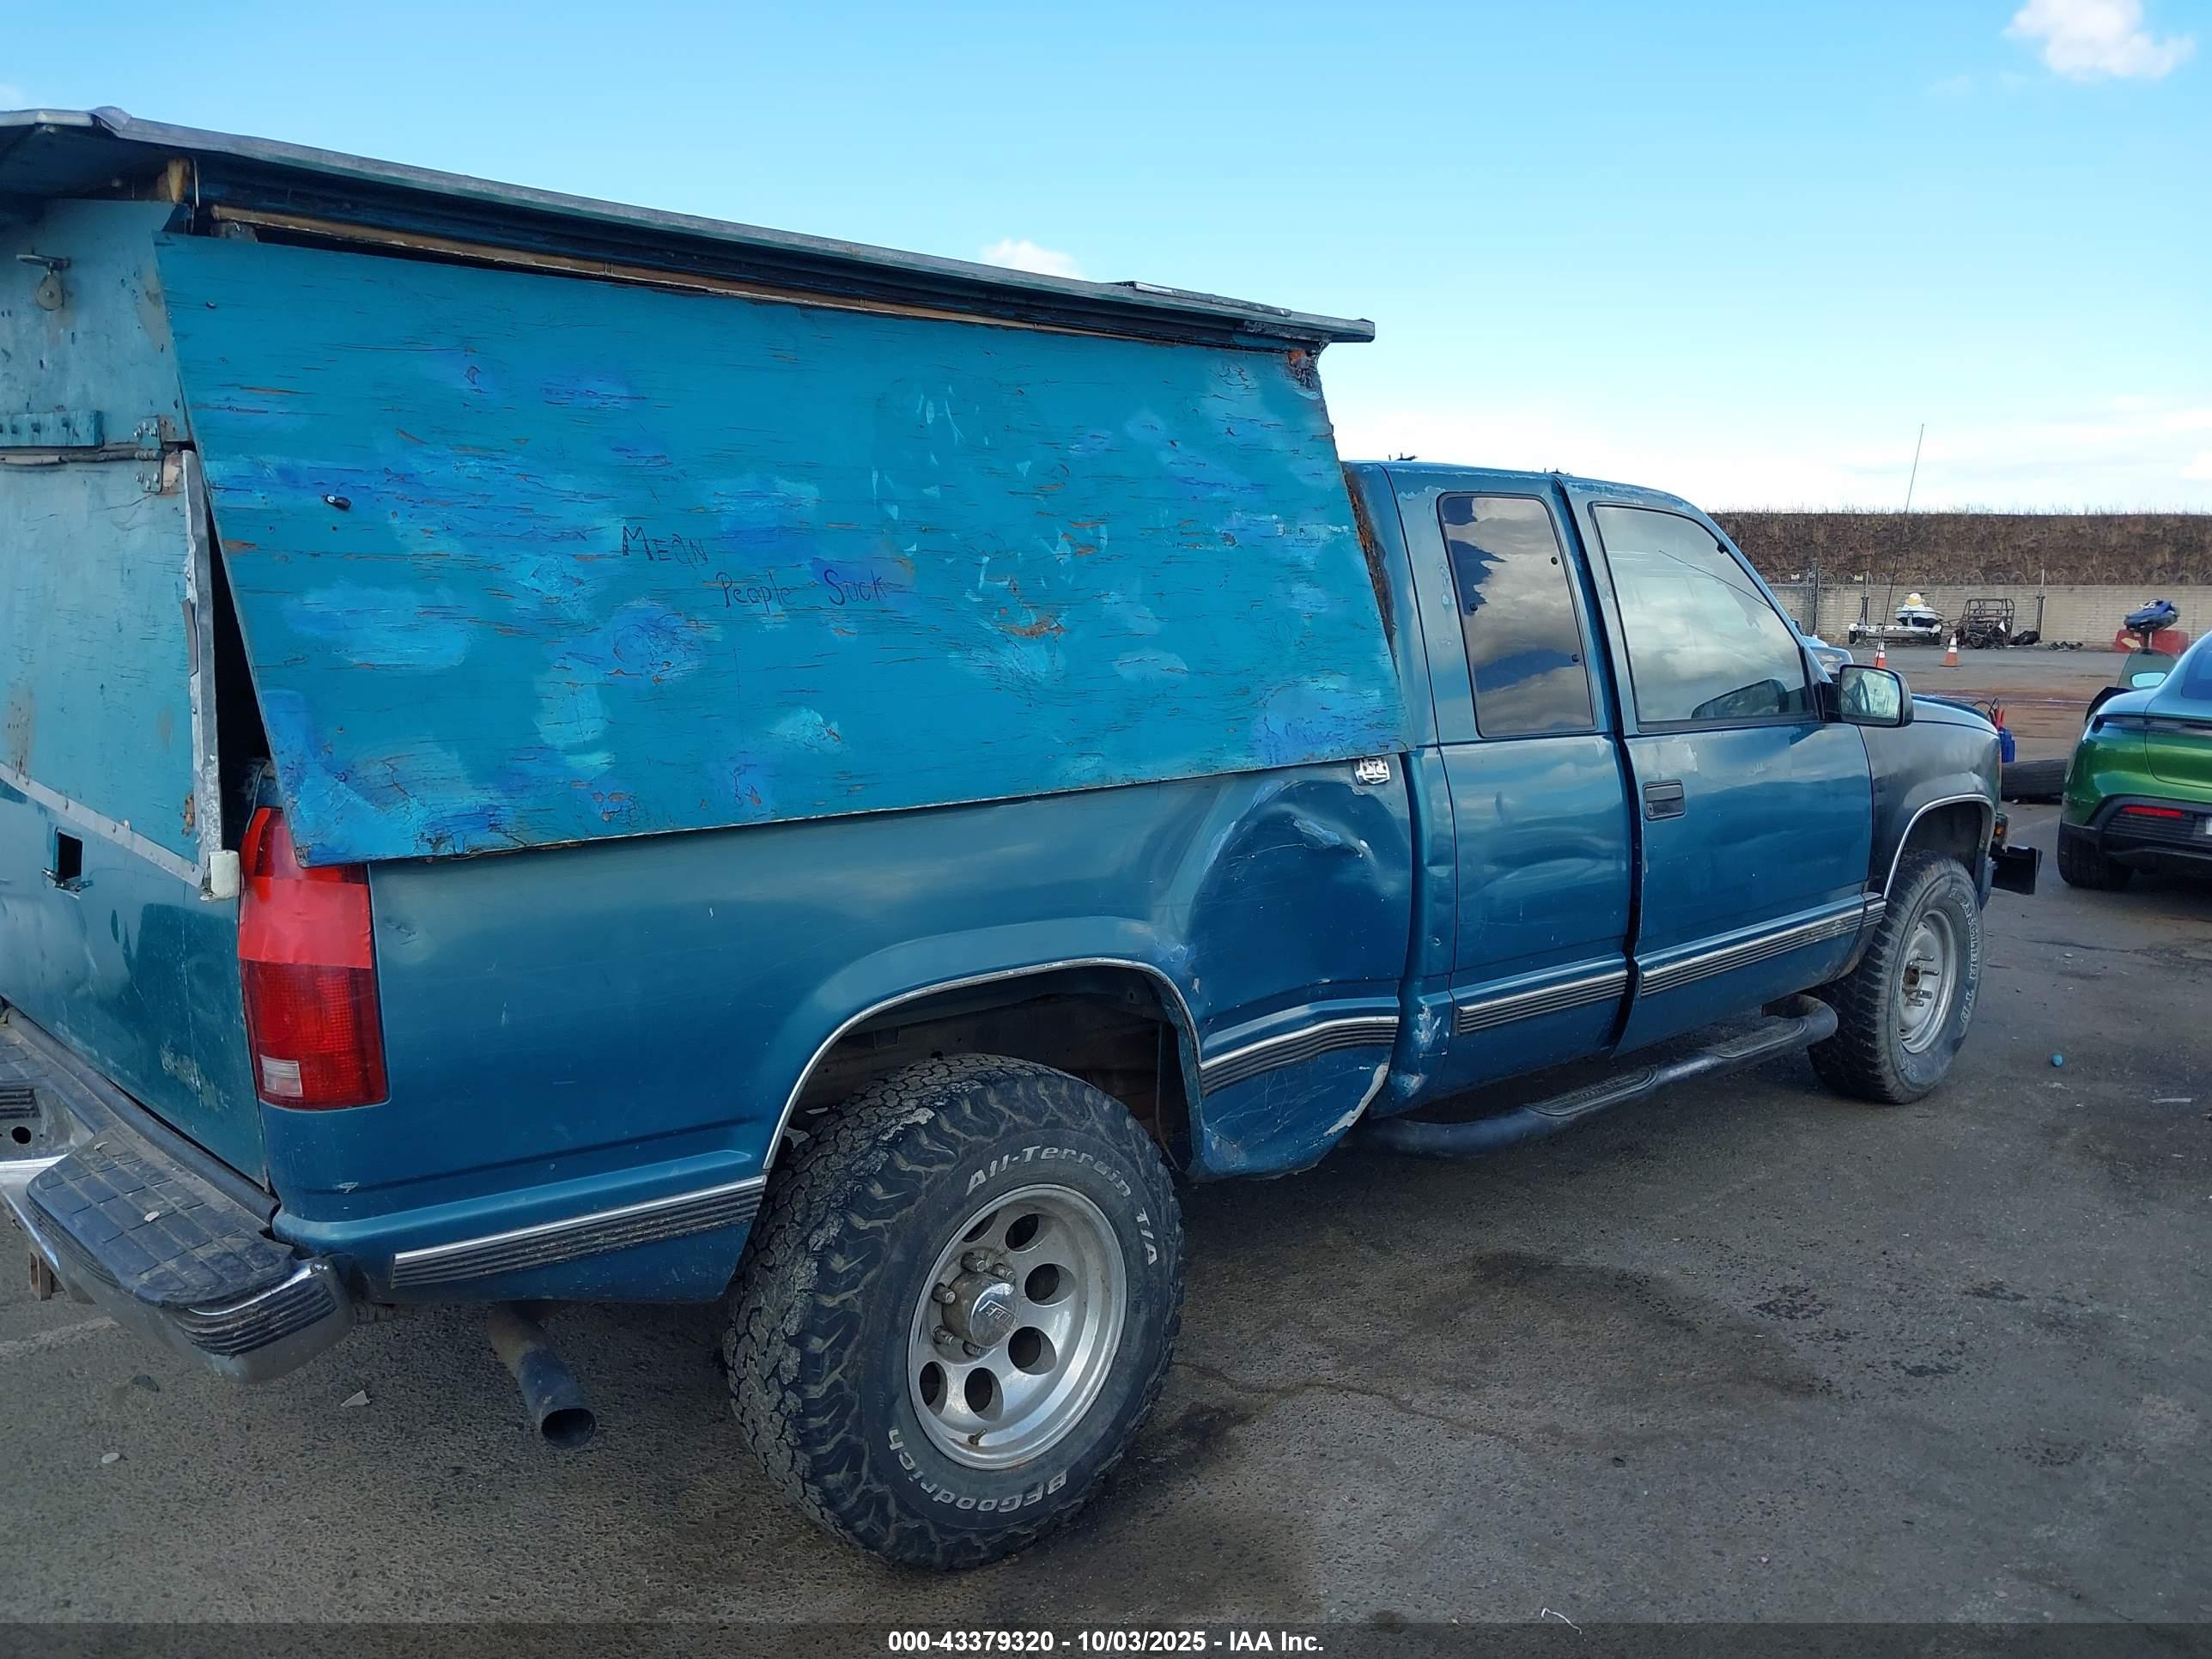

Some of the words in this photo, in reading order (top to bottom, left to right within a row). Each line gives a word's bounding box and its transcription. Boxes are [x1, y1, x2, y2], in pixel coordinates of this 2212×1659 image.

[716, 571, 796, 615] People
[824, 568, 888, 605] Suck
[1948, 887, 1979, 980] ANGLER
[965, 1146, 1132, 1198] All-Terrain
[887, 1426, 1068, 1514] BFGoodrich
